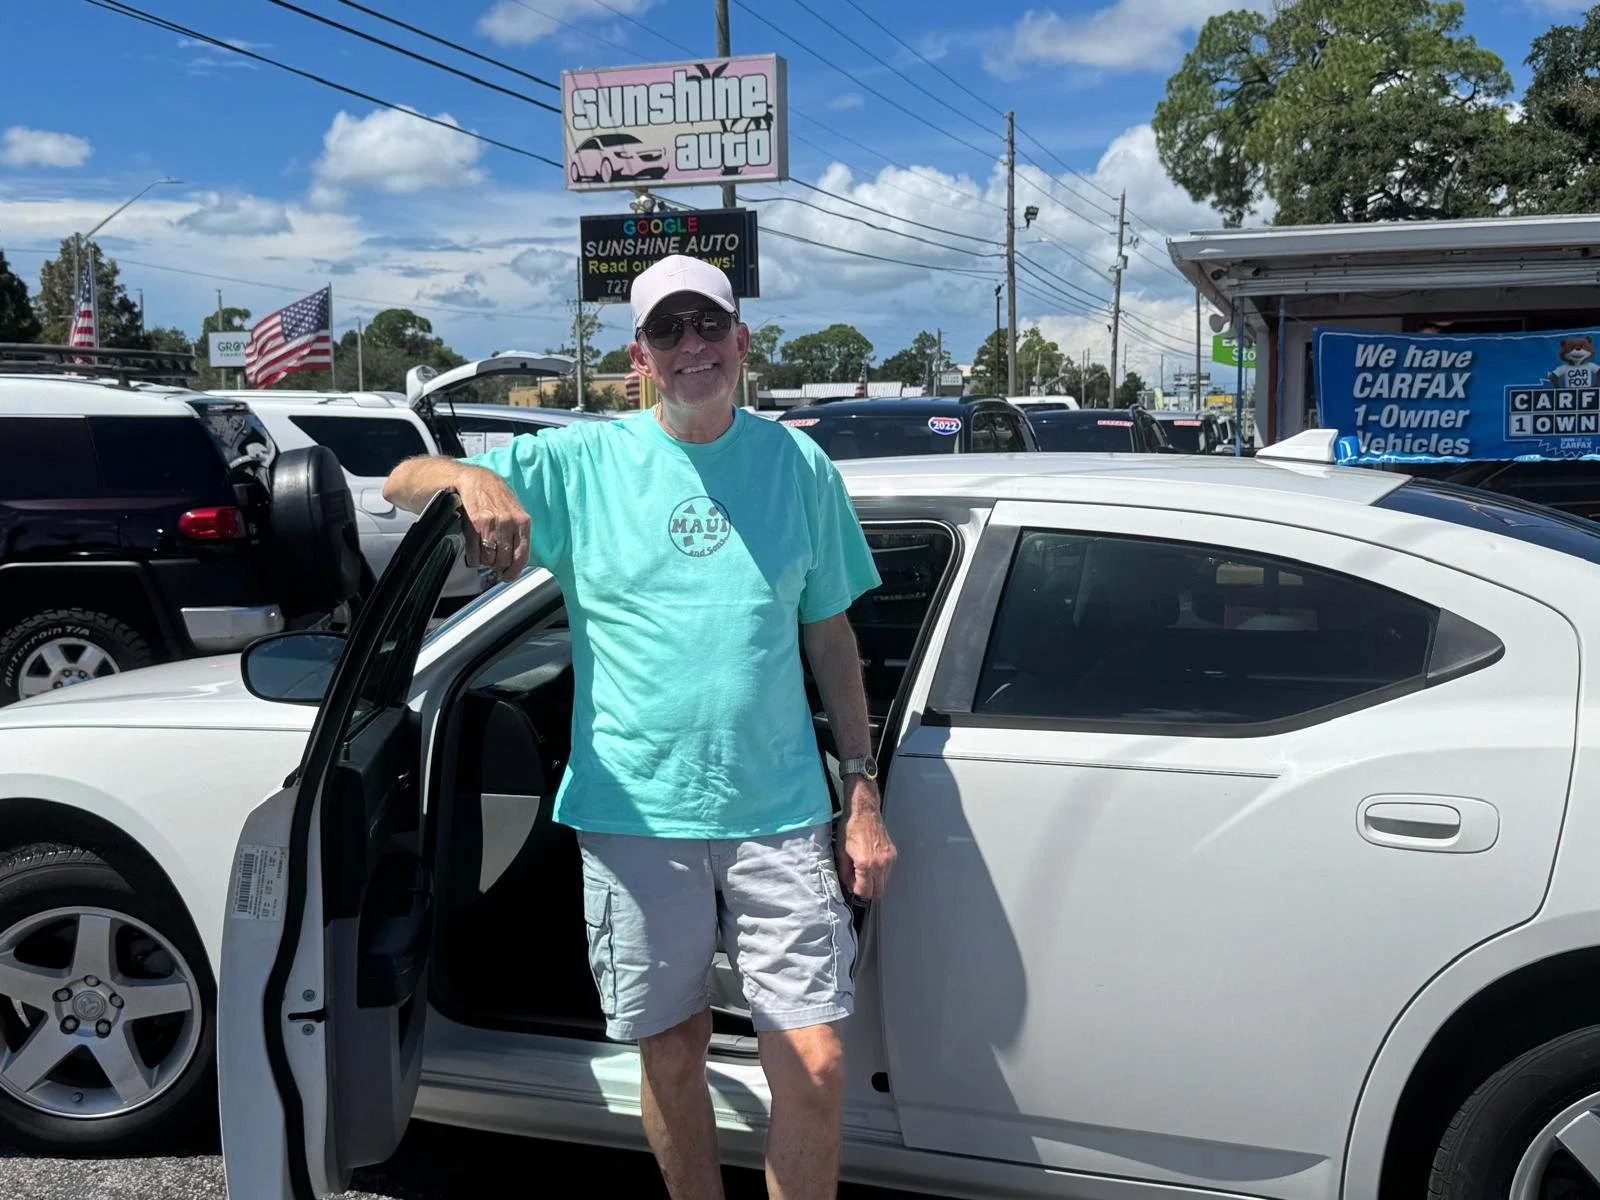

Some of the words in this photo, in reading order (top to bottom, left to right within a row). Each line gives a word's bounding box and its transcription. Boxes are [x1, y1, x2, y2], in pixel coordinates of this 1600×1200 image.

[623, 216, 698, 235] GOOGLE
[585, 237, 679, 257] SUNSHINE
[685, 234, 739, 253] AUTO
[588, 258, 627, 273] Read
[632, 259, 658, 272] ou
[606, 280, 629, 294] 727
[1354, 344, 1397, 368] We
[1403, 344, 1472, 368] have
[1567, 369, 1588, 378] CAR
[1352, 372, 1471, 399] CARFAX
[1568, 378, 1588, 386] FOX
[1514, 391, 1595, 410] CARF
[1354, 404, 1470, 428] 1-Owner
[1515, 417, 1526, 432] 1
[1536, 416, 1595, 432] OWN
[933, 420, 957, 430] 2022
[1356, 430, 1470, 455] Vehicles
[671, 518, 728, 533] MAUI
[65, 625, 90, 635] T/A
